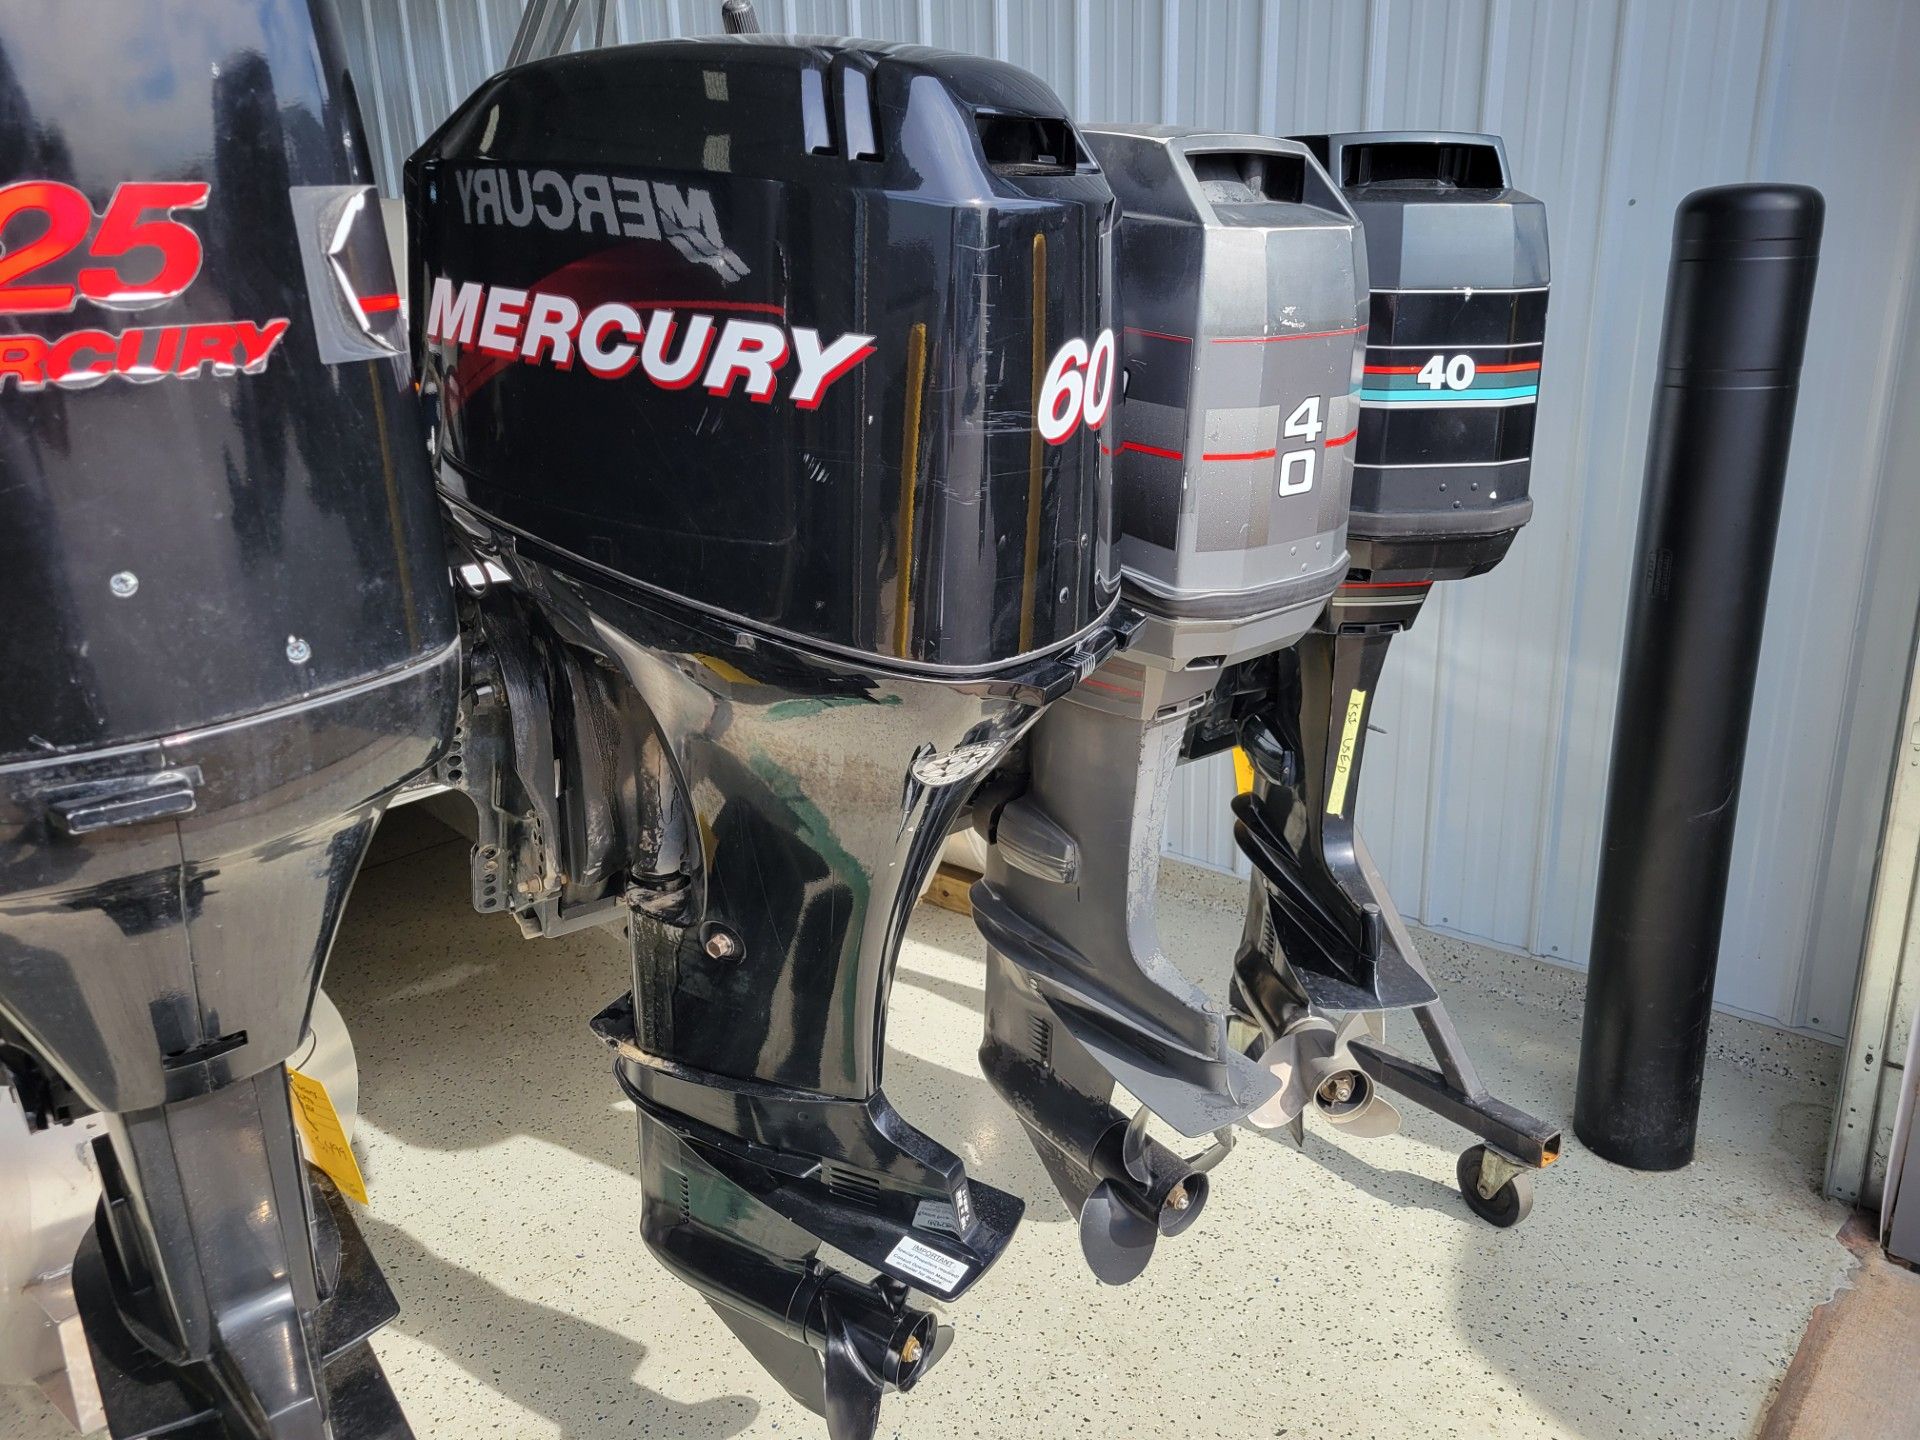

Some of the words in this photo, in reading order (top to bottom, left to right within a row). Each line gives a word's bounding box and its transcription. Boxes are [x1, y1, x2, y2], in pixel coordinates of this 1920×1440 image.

[427, 277, 877, 410] MERCURY
[1416, 354, 1476, 391] 40
[1038, 328, 1114, 446] 60
[912, 1244, 954, 1267] IMPORTANT
